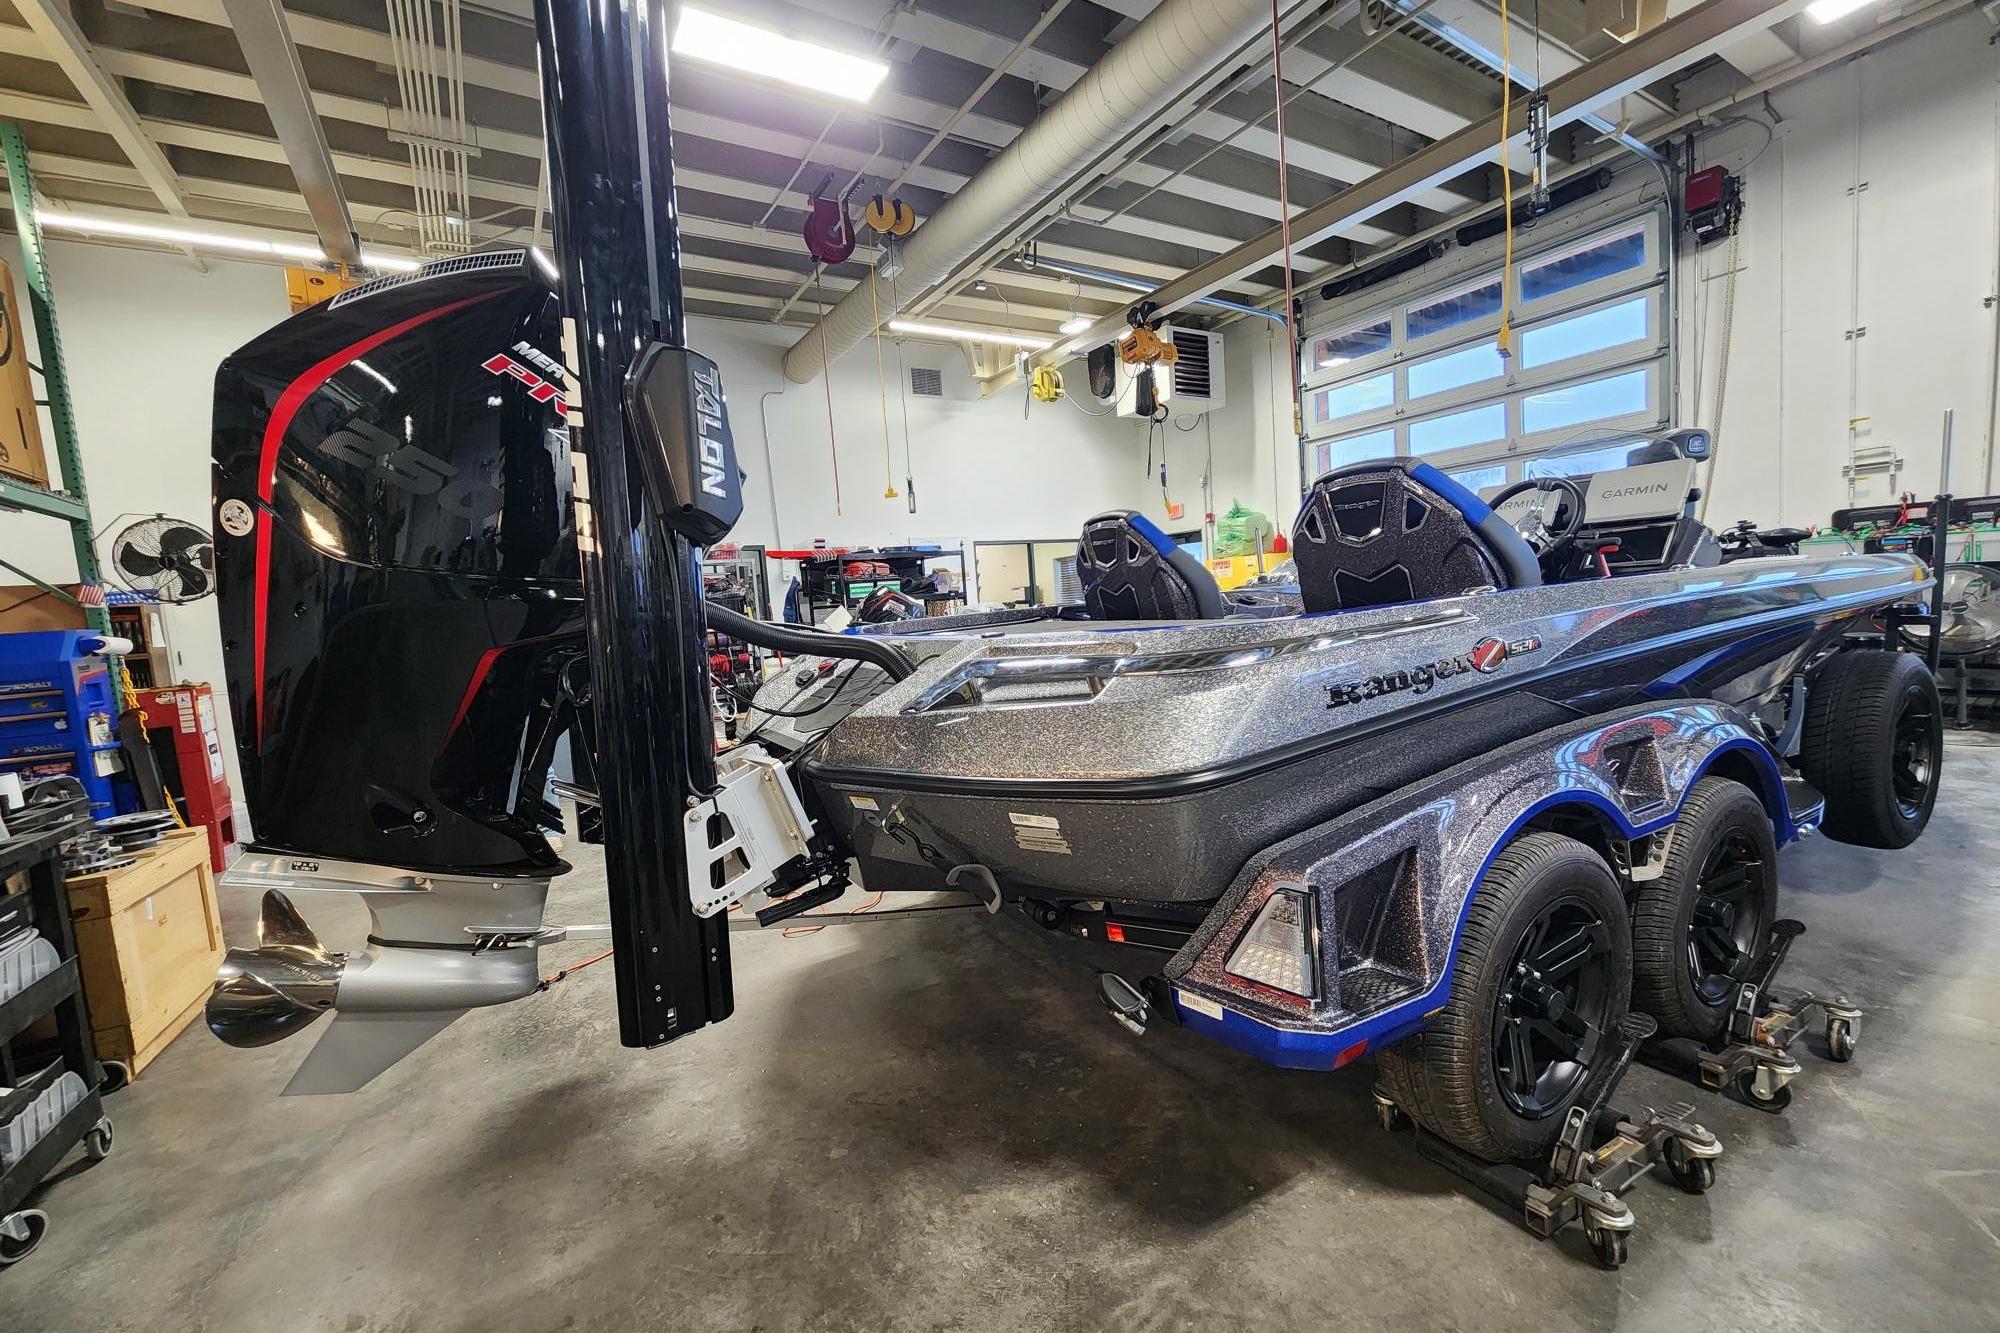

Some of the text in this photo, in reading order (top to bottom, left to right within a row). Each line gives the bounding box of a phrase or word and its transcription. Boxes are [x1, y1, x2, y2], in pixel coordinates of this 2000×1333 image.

[511, 340, 565, 380] MER
[480, 352, 568, 420] PR
[693, 366, 727, 500] TALON
[1498, 499, 1538, 511] ARMI
[1601, 482, 1669, 500] GARMIN
[1323, 650, 1475, 710] Ranger
